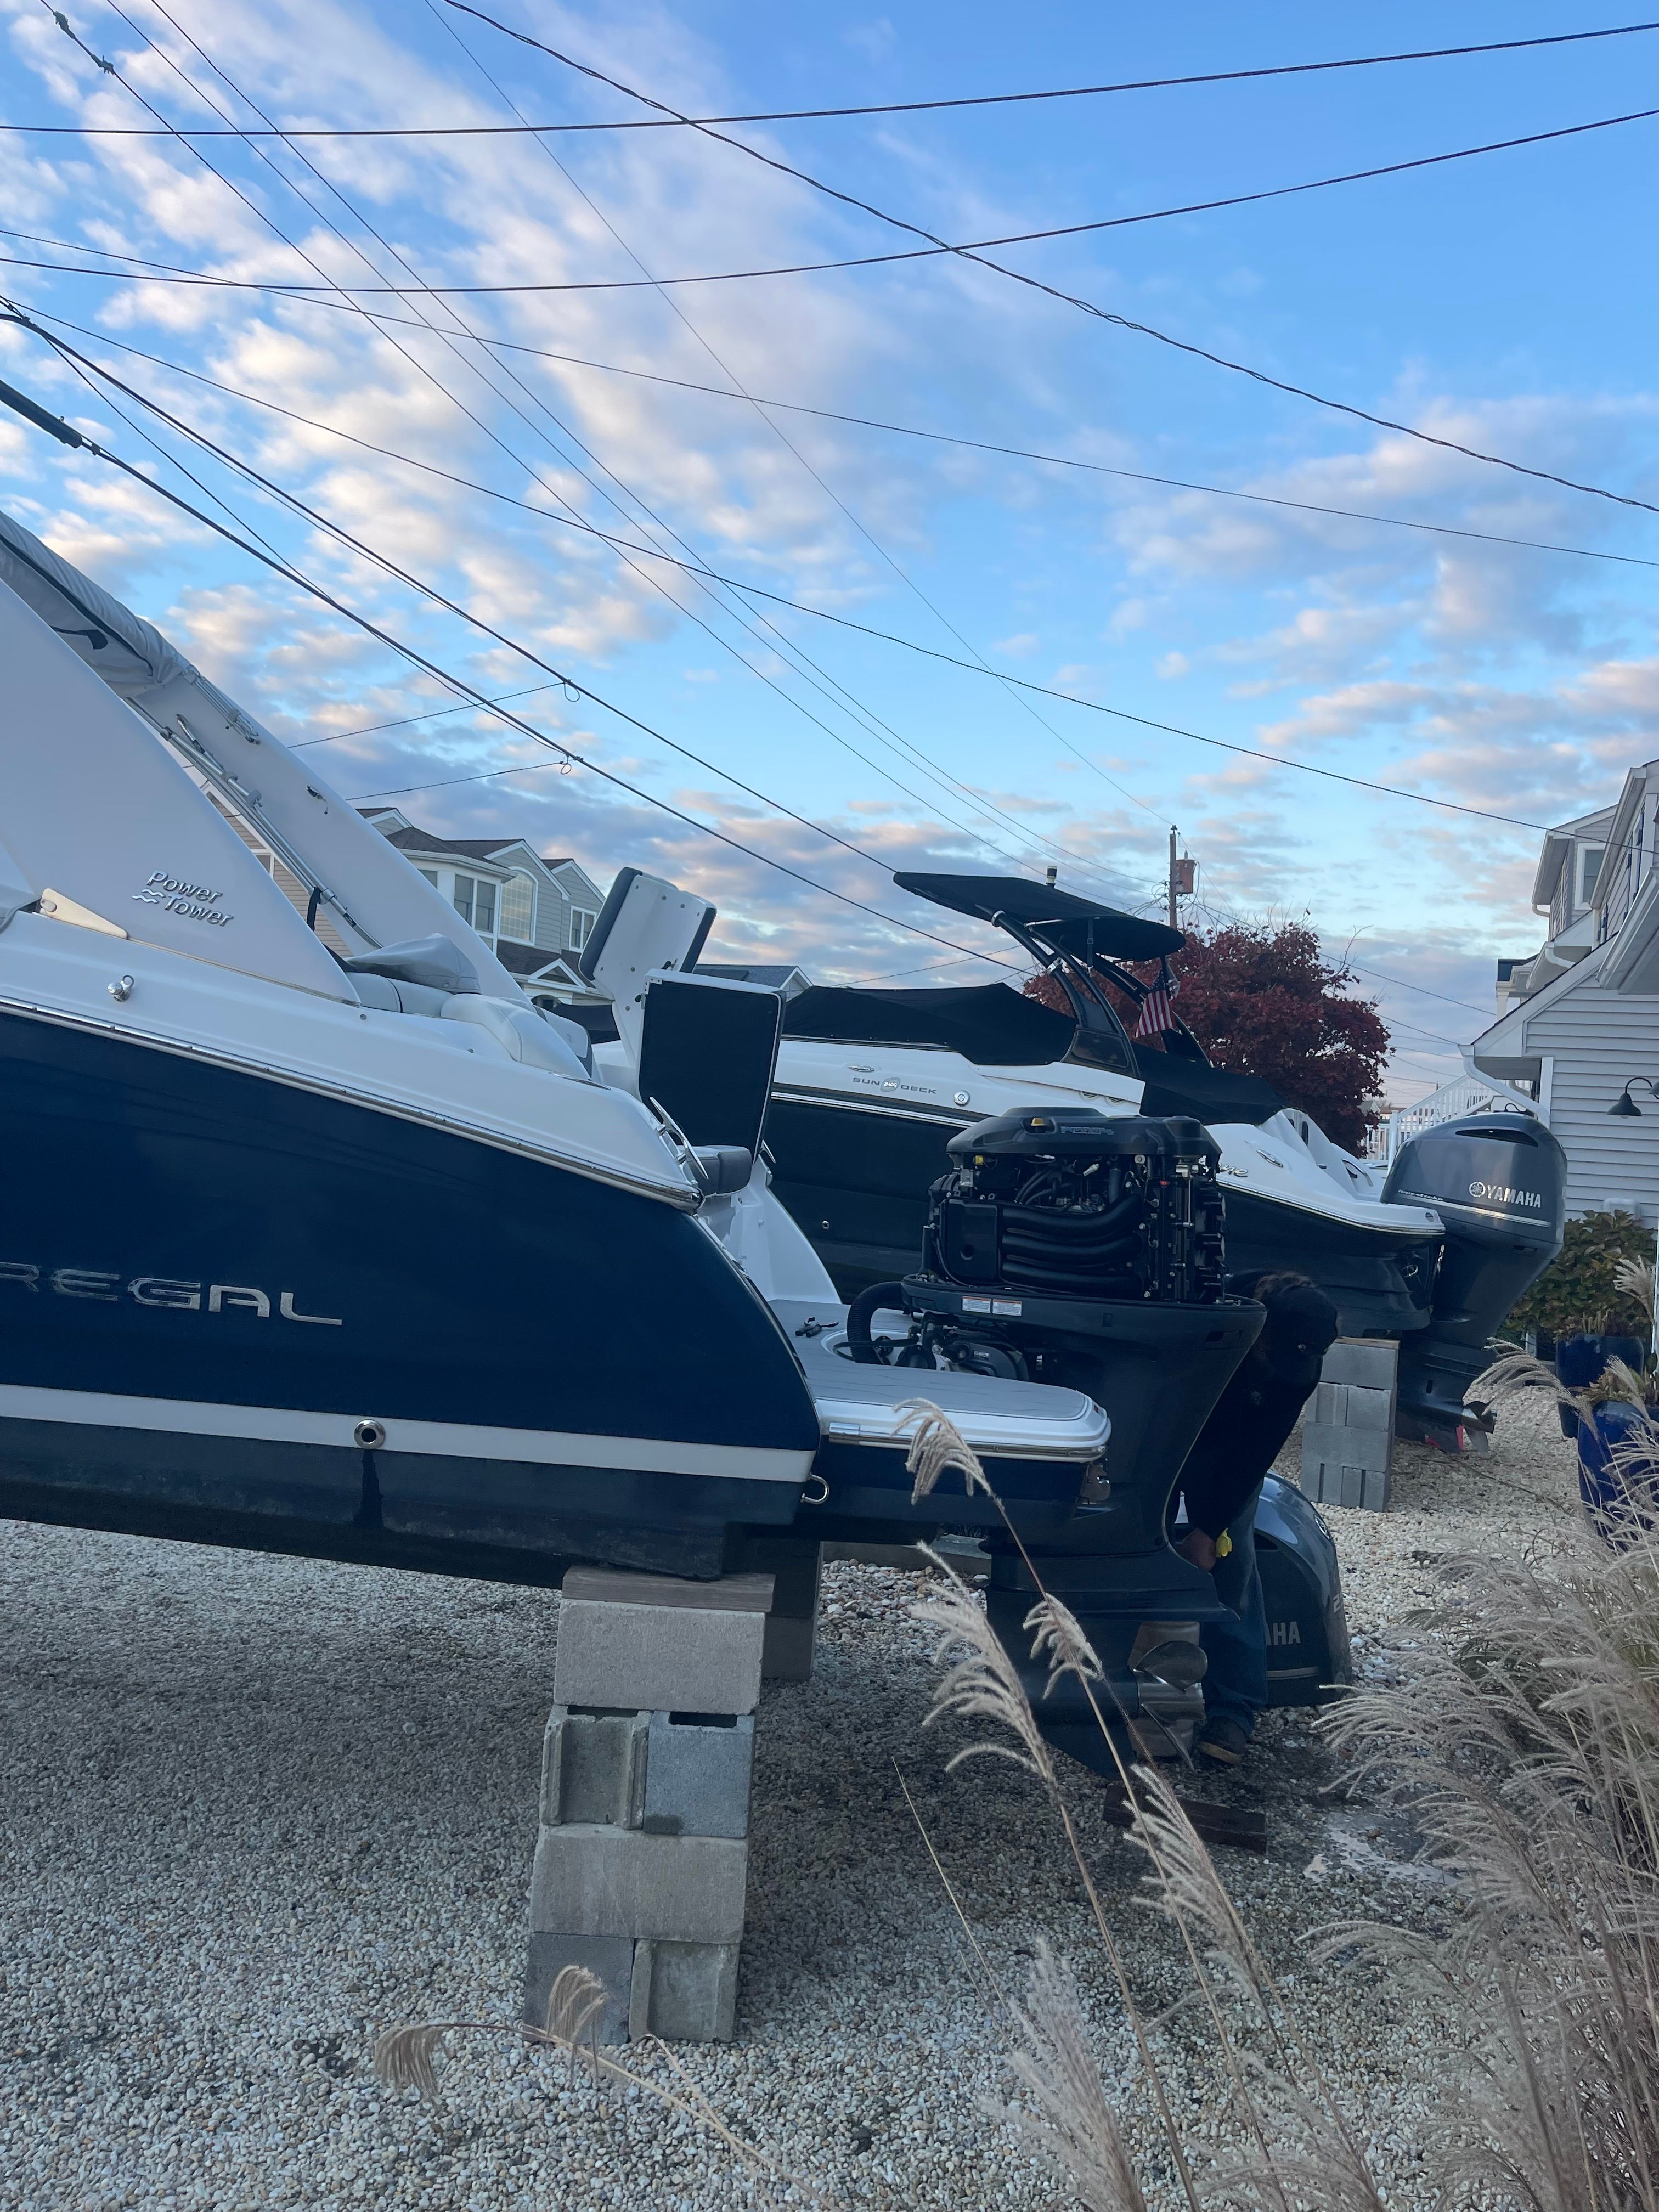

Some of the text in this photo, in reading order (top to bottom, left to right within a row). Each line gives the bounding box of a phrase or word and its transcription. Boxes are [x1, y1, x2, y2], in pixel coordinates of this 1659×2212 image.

[146, 869, 223, 904] Power
[165, 893, 235, 927] Tower
[853, 1077, 880, 1086] SUN
[901, 1085, 937, 1094] DECK
[1487, 1184, 1541, 1208] YAMAHA
